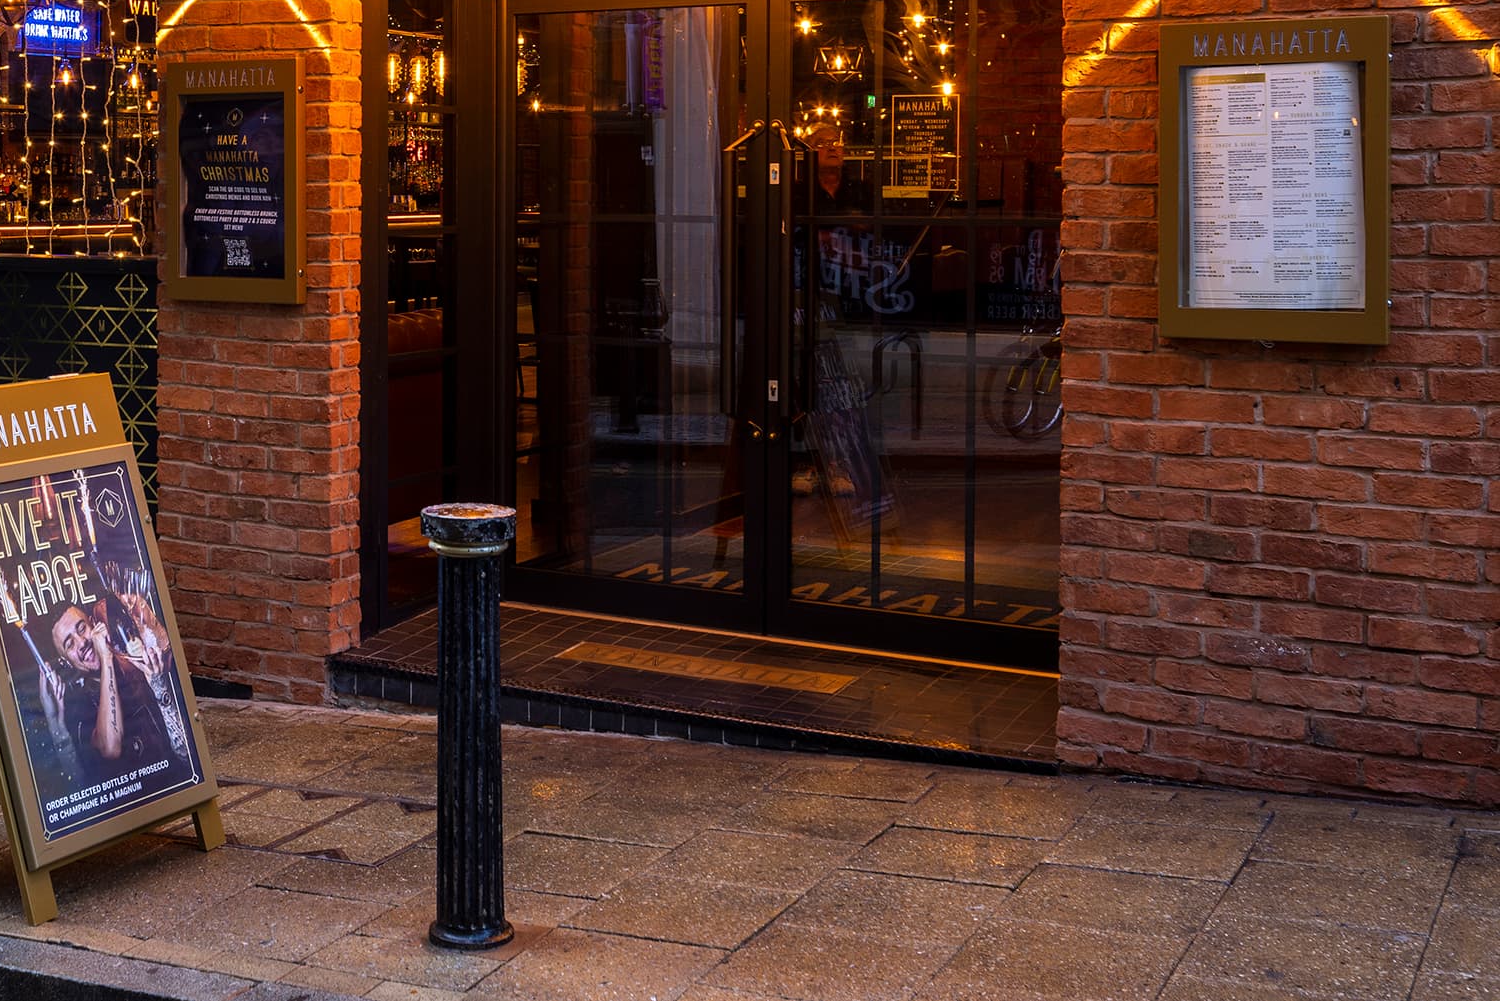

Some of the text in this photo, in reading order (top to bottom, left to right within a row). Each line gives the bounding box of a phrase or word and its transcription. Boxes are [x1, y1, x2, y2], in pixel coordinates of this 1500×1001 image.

[32, 8, 80, 23] SAVE WATER
[129, 0, 157, 16] WAL
[1193, 28, 1350, 57] MANAHATTA
[186, 67, 276, 88] MANAHATTA
[217, 134, 248, 146] HAVE A
[206, 150, 259, 163] MANAHATTA
[200, 166, 270, 183] CHRISTMAS
[104, 500, 114, 516] M
[55, 490, 83, 548] IT
[46, 760, 169, 812] ORDER SELECTED BOTTLES OF PROSECCO
[48, 782, 142, 824] OR CHAMPAGNE AS A MAGNUM
